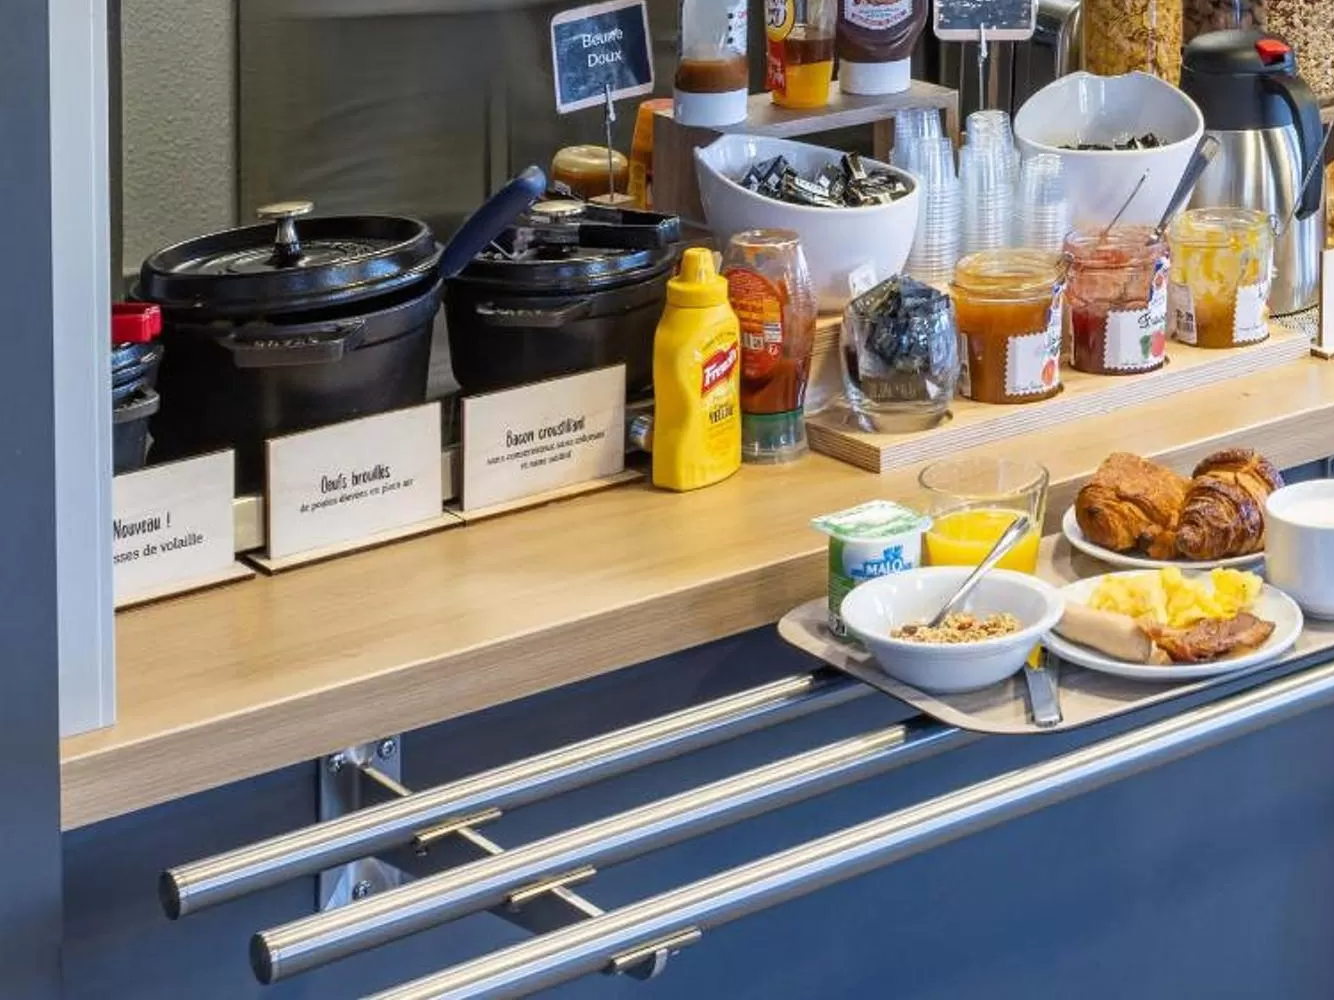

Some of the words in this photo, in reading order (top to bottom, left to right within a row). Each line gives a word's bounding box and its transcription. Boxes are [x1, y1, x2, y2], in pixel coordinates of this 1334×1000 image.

[587, 50, 623, 68] Doux
[506, 429, 535, 448] Bacon
[113, 515, 161, 541] Nouveau
[143, 544, 157, 557] de
[159, 533, 204, 552] volaille
